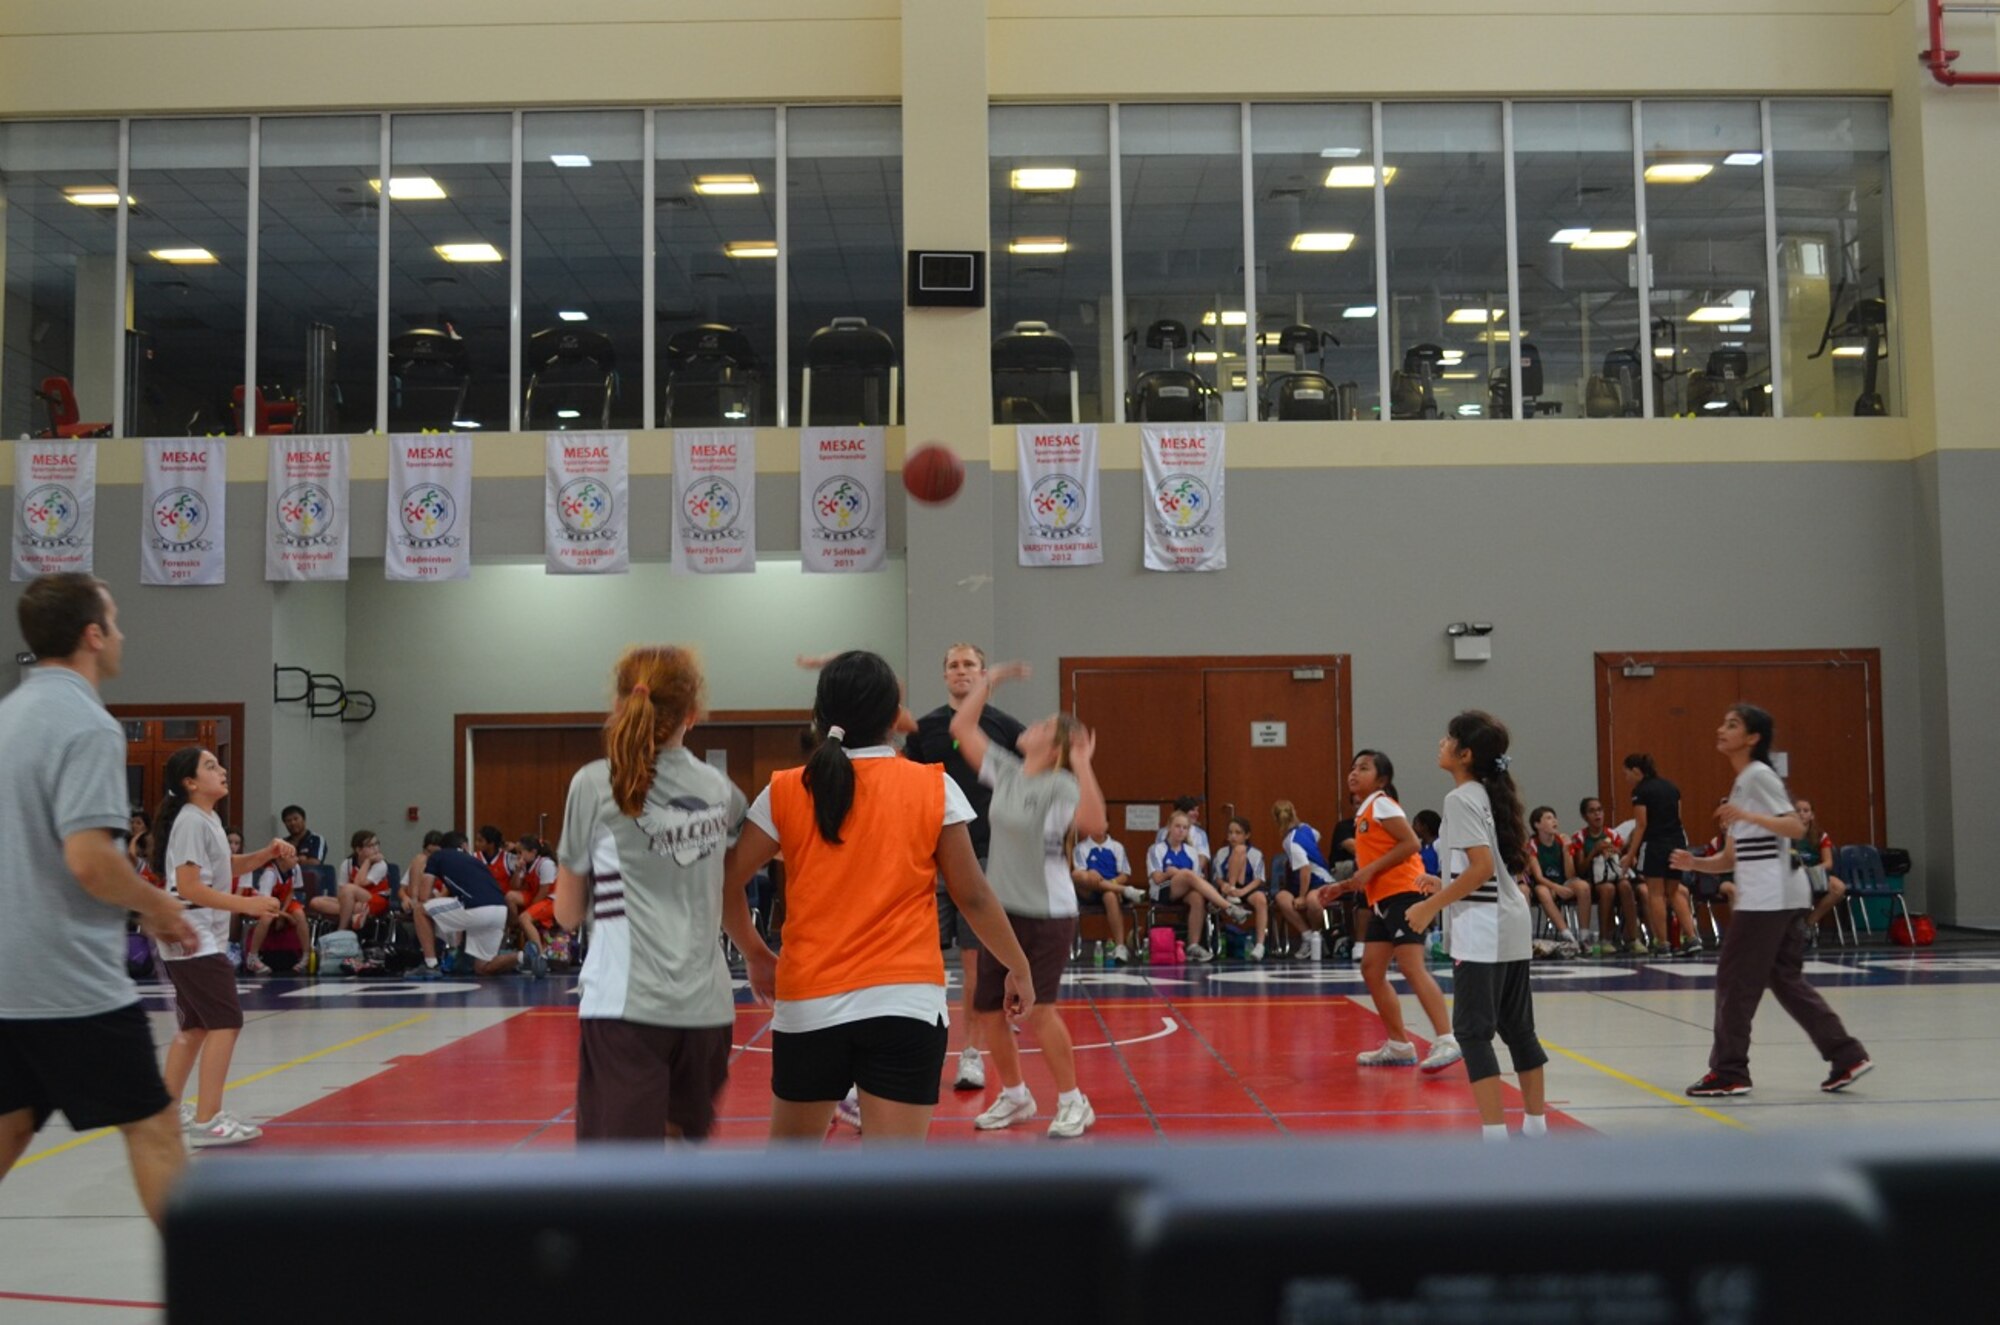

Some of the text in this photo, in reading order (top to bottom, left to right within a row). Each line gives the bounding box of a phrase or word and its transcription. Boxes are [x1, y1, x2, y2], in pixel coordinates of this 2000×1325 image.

[1036, 434, 1080, 446] MESAC
[1161, 438, 1205, 448] MESAC
[692, 445, 736, 456] MESAC
[820, 440, 865, 451] MESAC
[162, 452, 207, 462] MESAC
[287, 452, 331, 462] MESAC
[408, 448, 453, 458] MESAC
[564, 447, 608, 457] MESAC
[32, 454, 77, 465] MESAC
[1054, 543, 1097, 551] BASKETBALL
[648, 816, 728, 850] FALCONS
